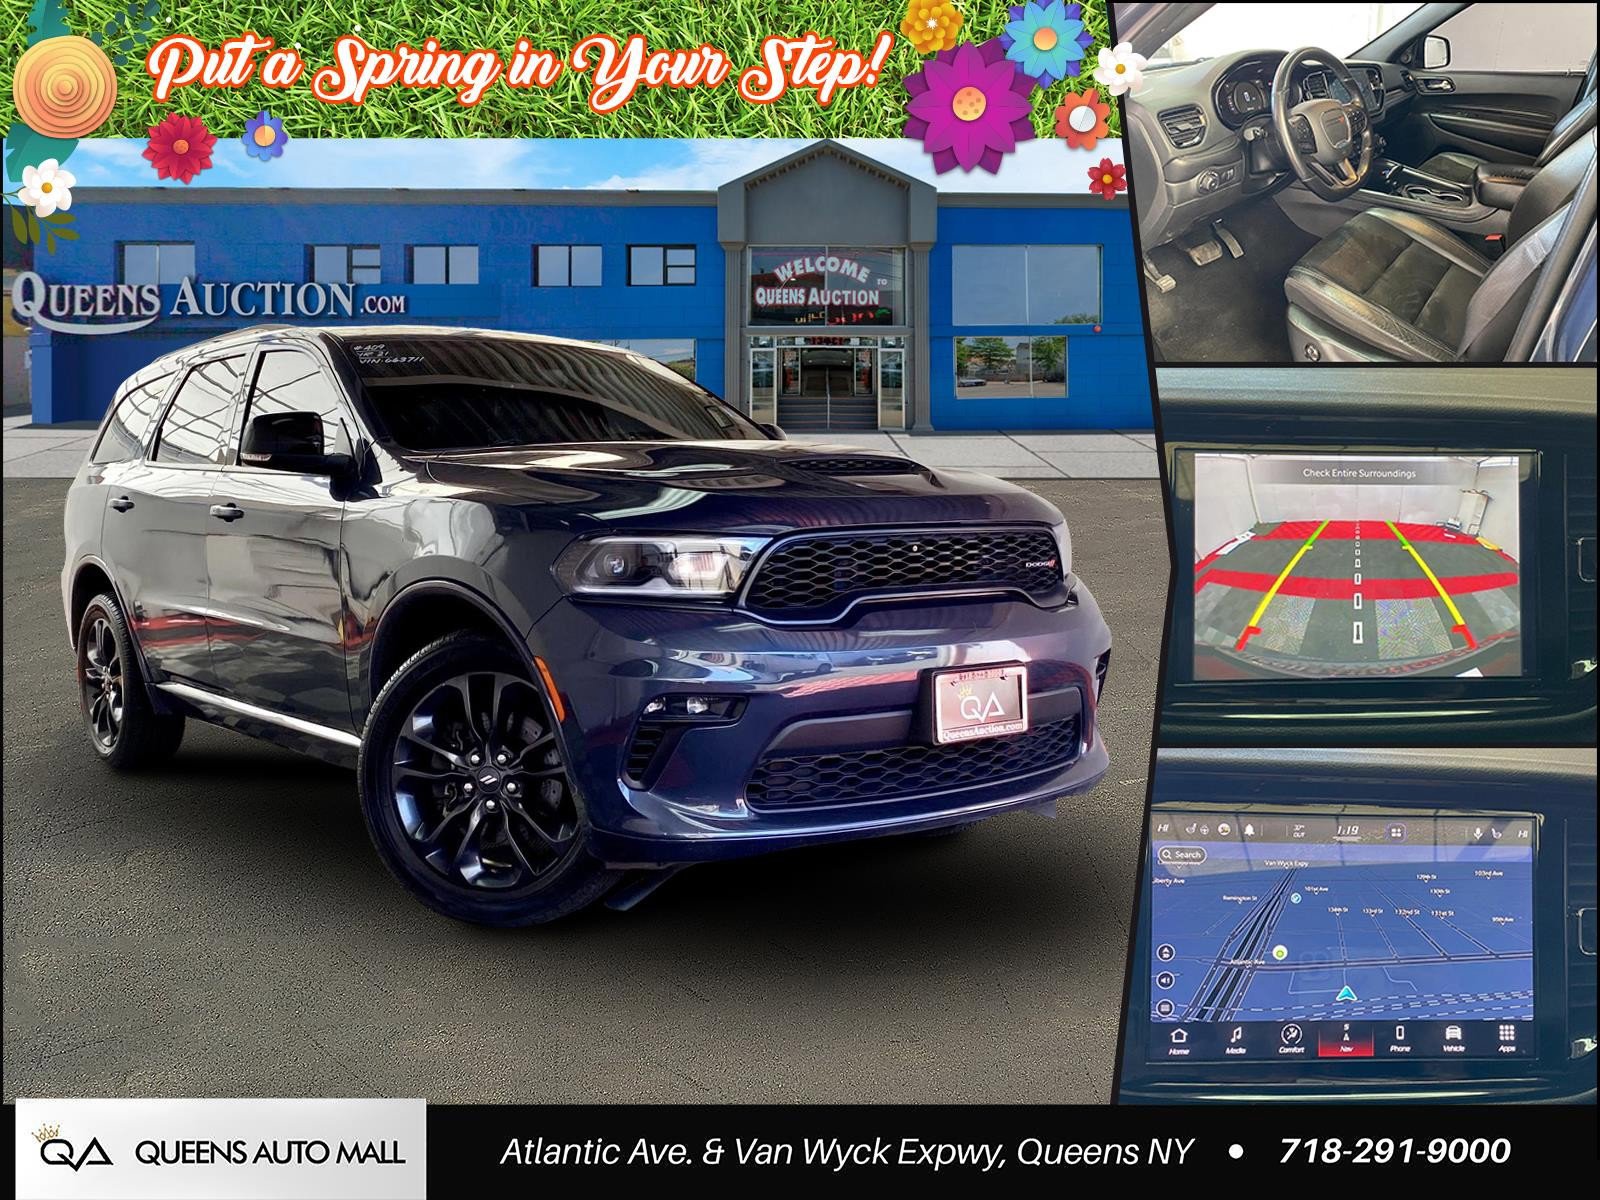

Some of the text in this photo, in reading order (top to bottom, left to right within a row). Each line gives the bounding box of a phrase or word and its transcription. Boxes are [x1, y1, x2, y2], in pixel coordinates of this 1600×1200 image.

[774, 256, 871, 283] WELCOME
[755, 286, 880, 307] QUEENS AUCTION
[12, 271, 406, 335] QUEENS AUCTION .COM
[1302, 468, 1417, 480] Check Entire Surroundings
[1157, 823, 1170, 832] HI
[1336, 825, 1360, 836] 1:19
[1518, 829, 1529, 838] HI
[1175, 850, 1203, 859] Search
[1152, 877, 1172, 886] iberty
[1168, 1047, 1190, 1056] Home
[1225, 1047, 1247, 1055] Media
[1278, 1046, 1305, 1054] Comfort
[1390, 1045, 1411, 1053] Phone
[1443, 1045, 1466, 1053] Vehicle
[1498, 1045, 1516, 1053] Apps
